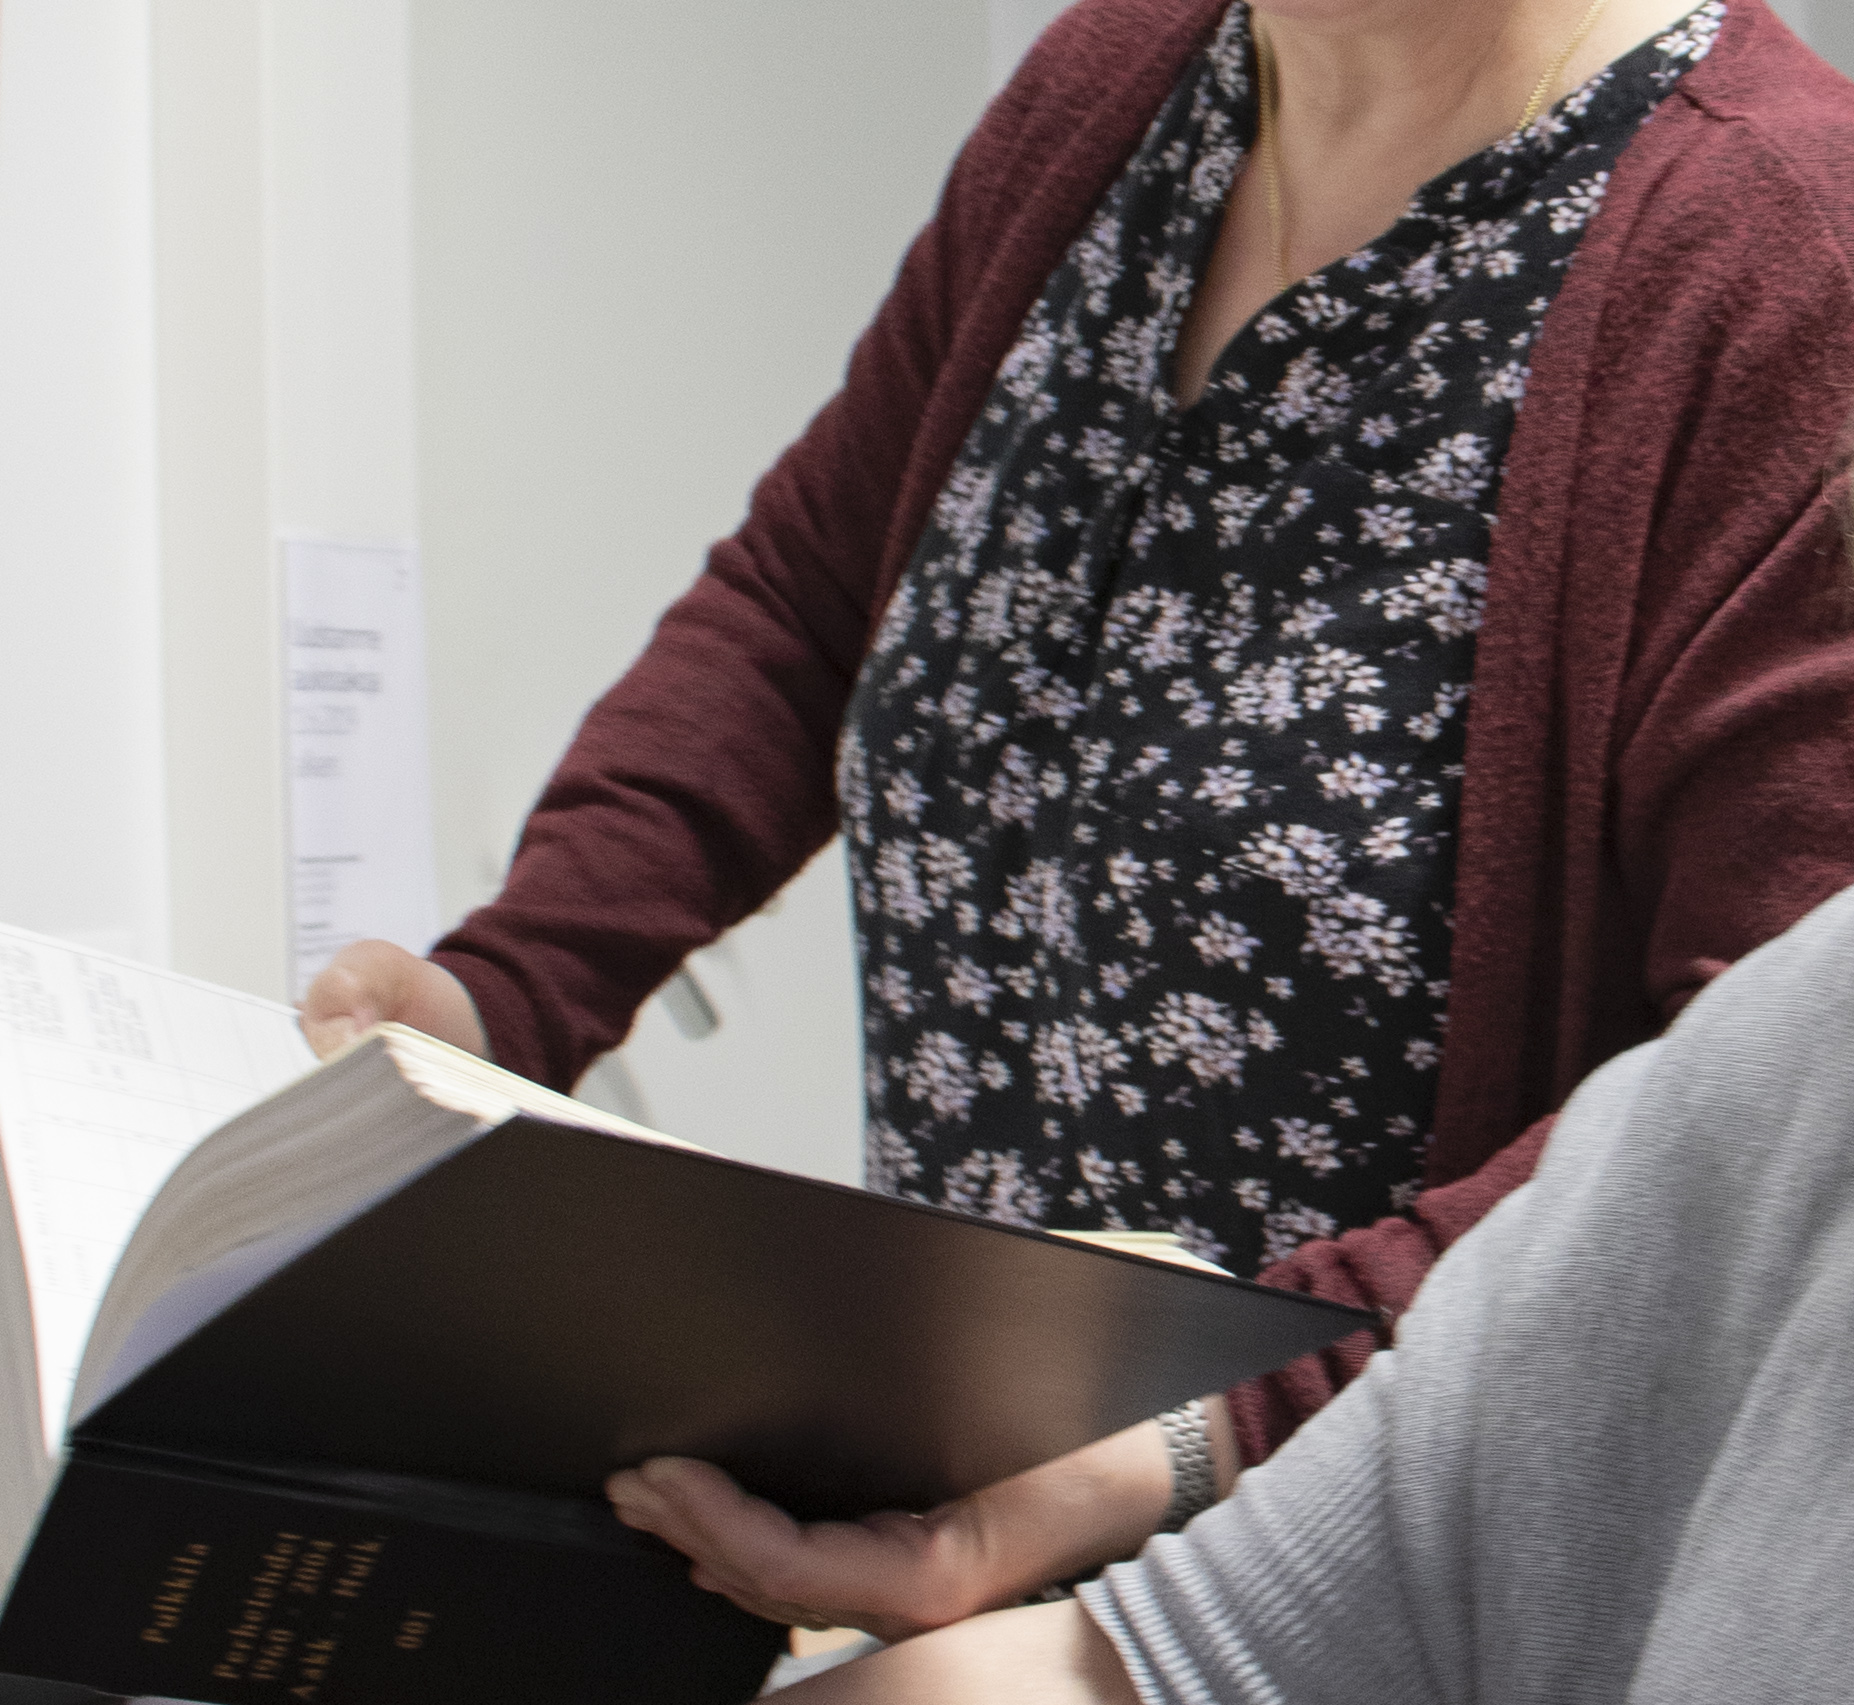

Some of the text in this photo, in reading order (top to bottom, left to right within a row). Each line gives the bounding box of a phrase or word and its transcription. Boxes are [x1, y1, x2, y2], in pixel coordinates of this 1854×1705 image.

[140, 1543, 212, 1644] Pulkkila
[210, 1531, 305, 1679] Perhelehdet
[250, 1628, 296, 1681] 1960
[288, 1539, 337, 1595] 2004
[393, 1610, 436, 1650] 001
